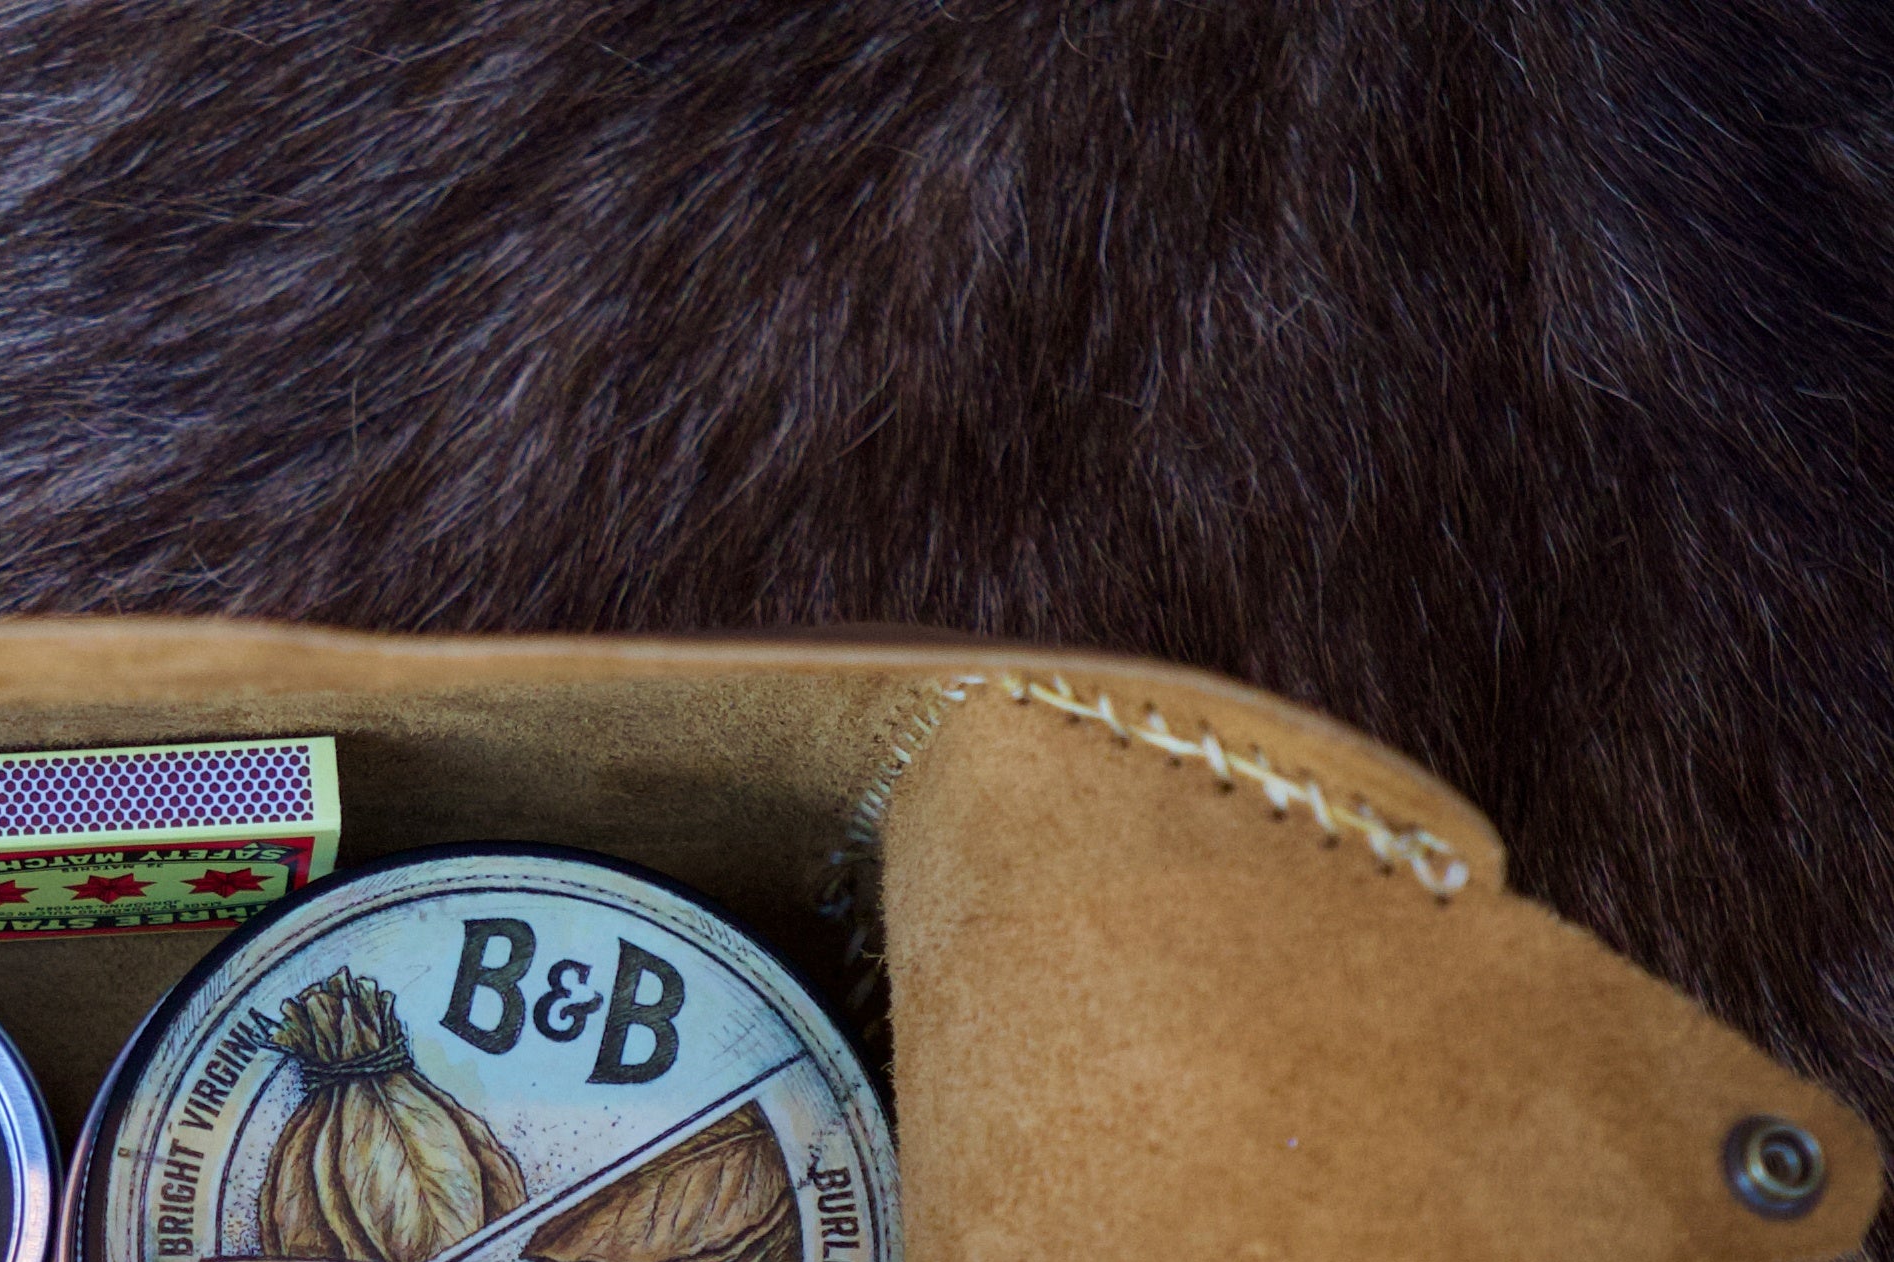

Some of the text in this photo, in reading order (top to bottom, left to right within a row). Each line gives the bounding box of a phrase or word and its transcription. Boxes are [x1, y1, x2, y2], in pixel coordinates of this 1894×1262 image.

[139, 849, 287, 861] SAFETY
[439, 918, 685, 1085] B&B
[157, 1138, 205, 1257] BRIGHT
